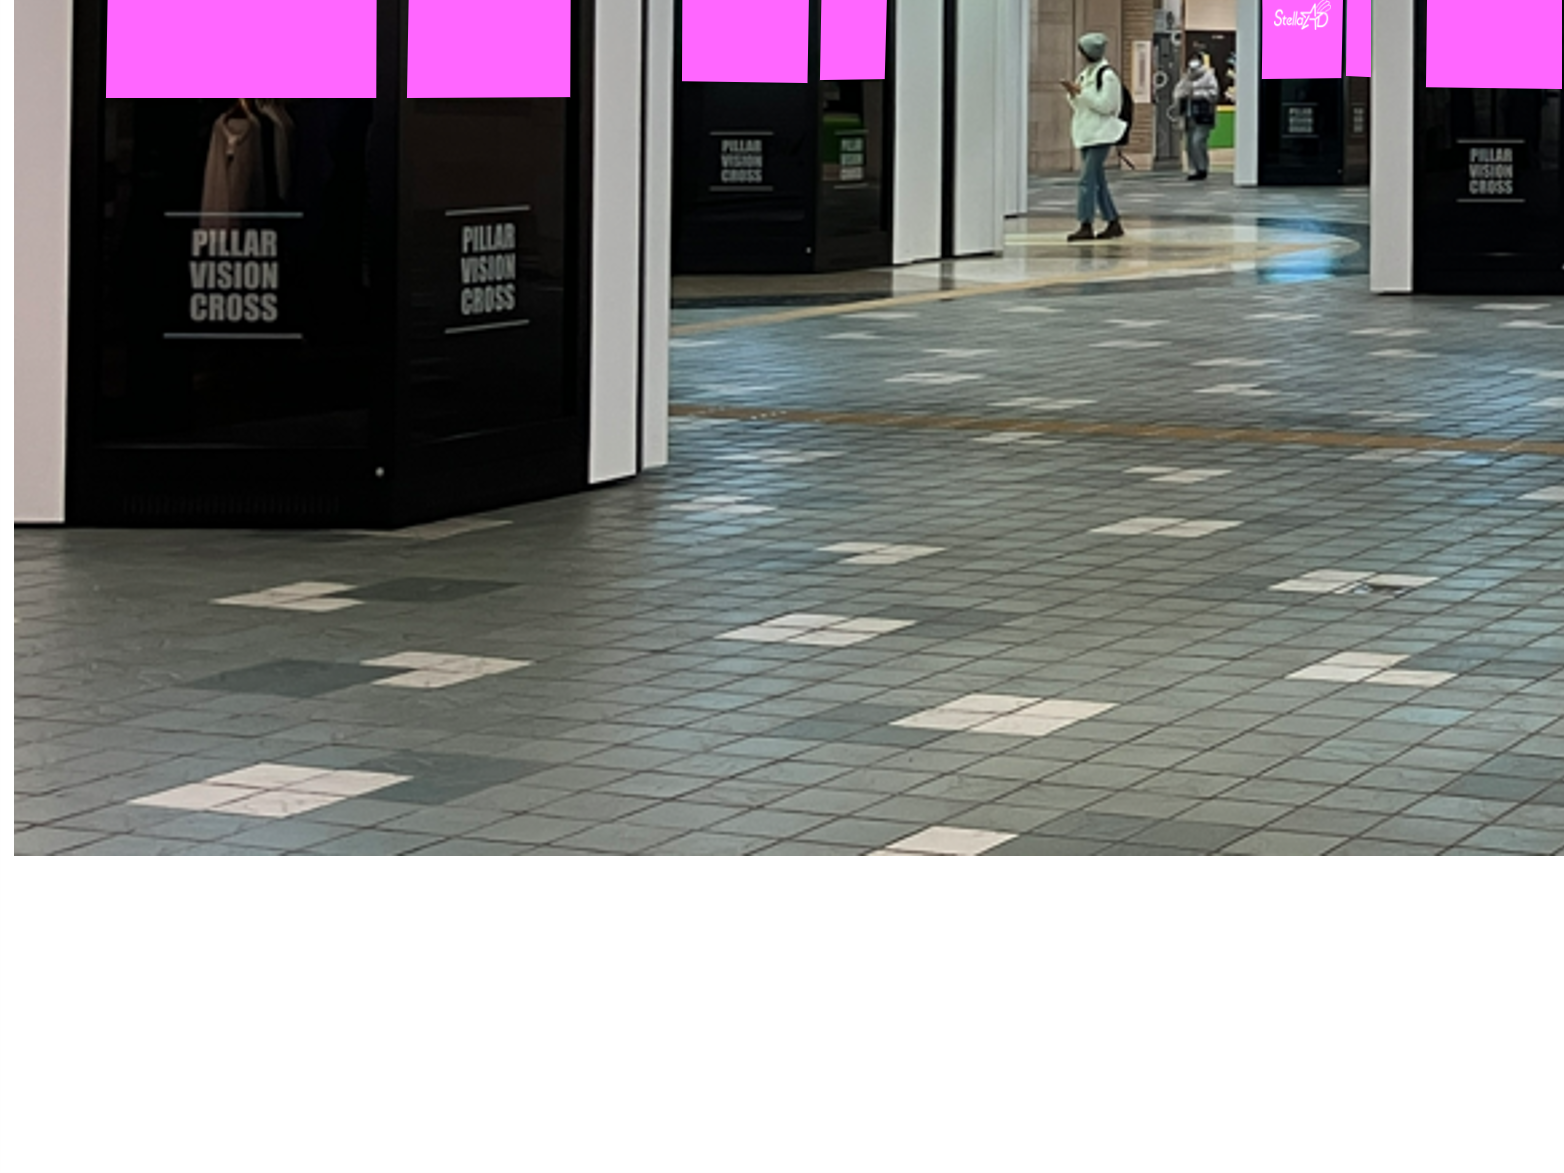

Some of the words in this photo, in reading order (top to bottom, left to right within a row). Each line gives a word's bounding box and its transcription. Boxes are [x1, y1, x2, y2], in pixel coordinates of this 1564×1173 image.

[190, 228, 278, 257] PILLAR
[460, 222, 516, 254] PILLAR
[190, 260, 278, 290] VISION
[460, 253, 516, 284] VISION
[190, 292, 278, 322] CROSS
[460, 283, 516, 316] CROSS
